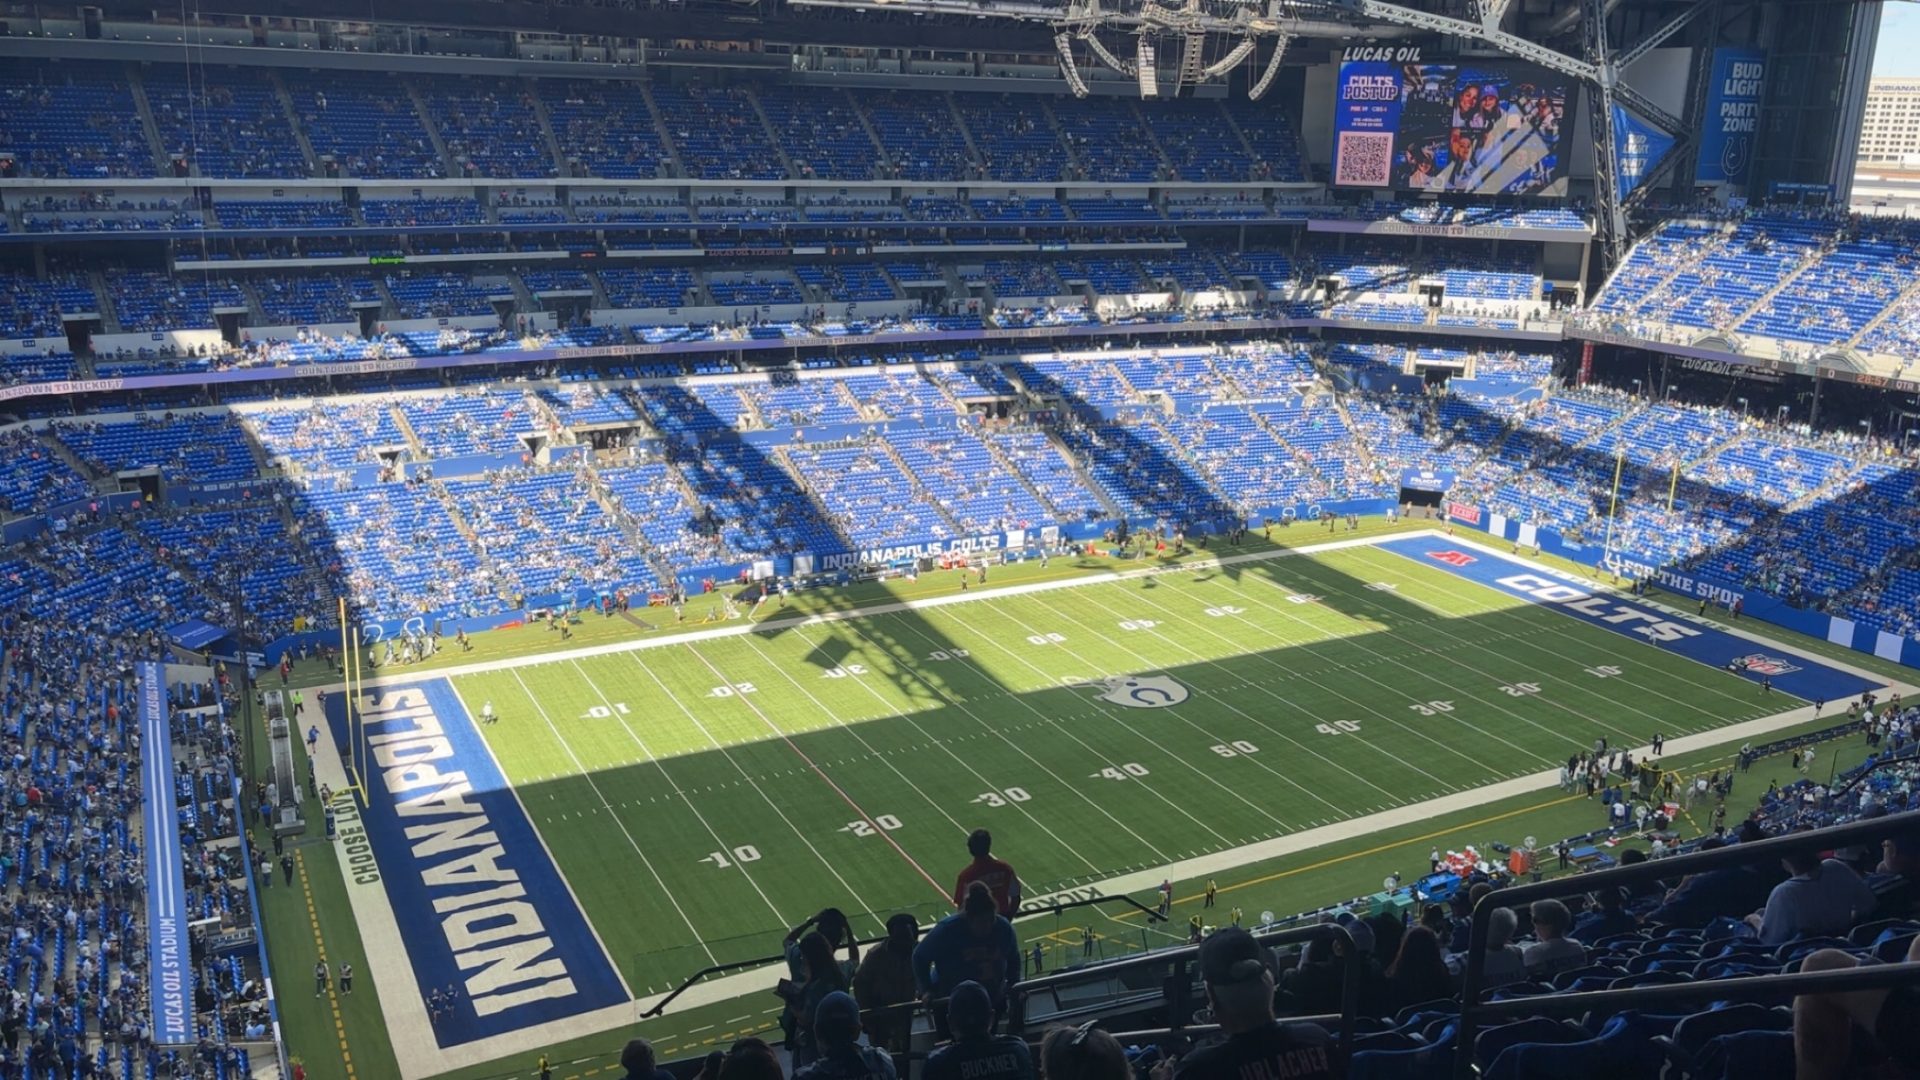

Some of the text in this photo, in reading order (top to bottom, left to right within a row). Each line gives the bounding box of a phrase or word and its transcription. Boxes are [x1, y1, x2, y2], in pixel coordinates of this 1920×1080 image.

[1343, 47, 1421, 61] LUCAS OIL
[1732, 62, 1763, 79] BUD
[1349, 76, 1393, 86] COLTS
[1343, 86, 1398, 100] POSTUP
[1722, 118, 1755, 132] ZONE
[1382, 224, 1512, 238] COUNTDOWN TO KICKOFF
[556, 347, 612, 358] COUNTDOWN
[295, 359, 416, 376] COUNTDOWN TO KICKOFF
[1681, 359, 1713, 371] LUCAS
[53, 383, 70, 392] TO
[71, 379, 122, 391] KICKOFF
[1896, 382, 1915, 392] QTR
[823, 534, 1000, 569] INDIANAPOLIS COLTS
[1659, 571, 1694, 591] THE
[1496, 574, 1703, 642] COLTS
[1584, 666, 1623, 678] 10
[711, 681, 758, 697] 20
[1498, 682, 1542, 697] 20
[589, 702, 631, 718] 10
[1408, 700, 1455, 716] 30
[1315, 720, 1361, 735] 40
[1210, 740, 1260, 758] 50
[1101, 762, 1150, 781] 40
[978, 786, 1032, 807] 30
[847, 814, 903, 837] 20
[340, 826, 380, 886] CHOOSE
[352, 688, 578, 1017] INDIANAPOLIS
[709, 845, 762, 868] 10
[159, 919, 185, 1033] LUCAS OIL STADIUM
[961, 1053, 1019, 1080] BUCKNER
[1239, 1047, 1329, 1080] URLACHER
